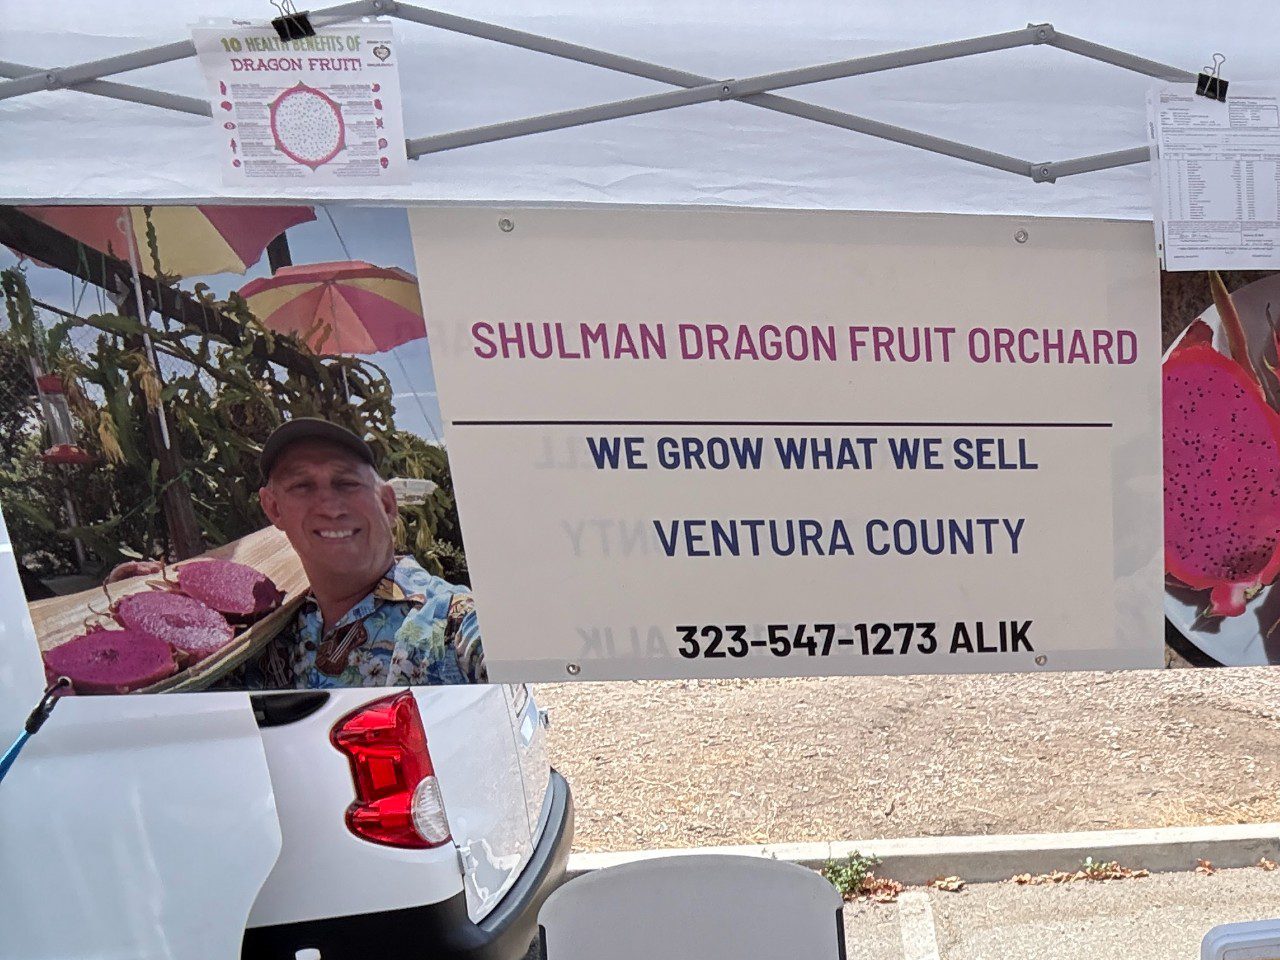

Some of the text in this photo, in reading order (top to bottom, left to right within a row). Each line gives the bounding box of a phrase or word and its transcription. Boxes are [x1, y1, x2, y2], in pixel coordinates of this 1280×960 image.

[220, 35, 362, 52] 10 HEALTH BENEFITS OF
[230, 58, 302, 72] DRAGON
[307, 58, 362, 72] FRUIT!
[471, 321, 668, 360] SHULMAN
[678, 323, 837, 361] DRAGON
[849, 325, 956, 363] FRUIT
[968, 327, 1138, 365] ORCHARD
[586, 436, 648, 470] WE
[656, 436, 763, 470] GROW
[773, 436, 878, 470] WHAT
[887, 437, 944, 470] WE
[953, 437, 1039, 470] SELL
[652, 518, 855, 557] VENTURA
[865, 517, 1026, 556] COUNTY
[675, 619, 1035, 659] 323-547-1273 ALIK
